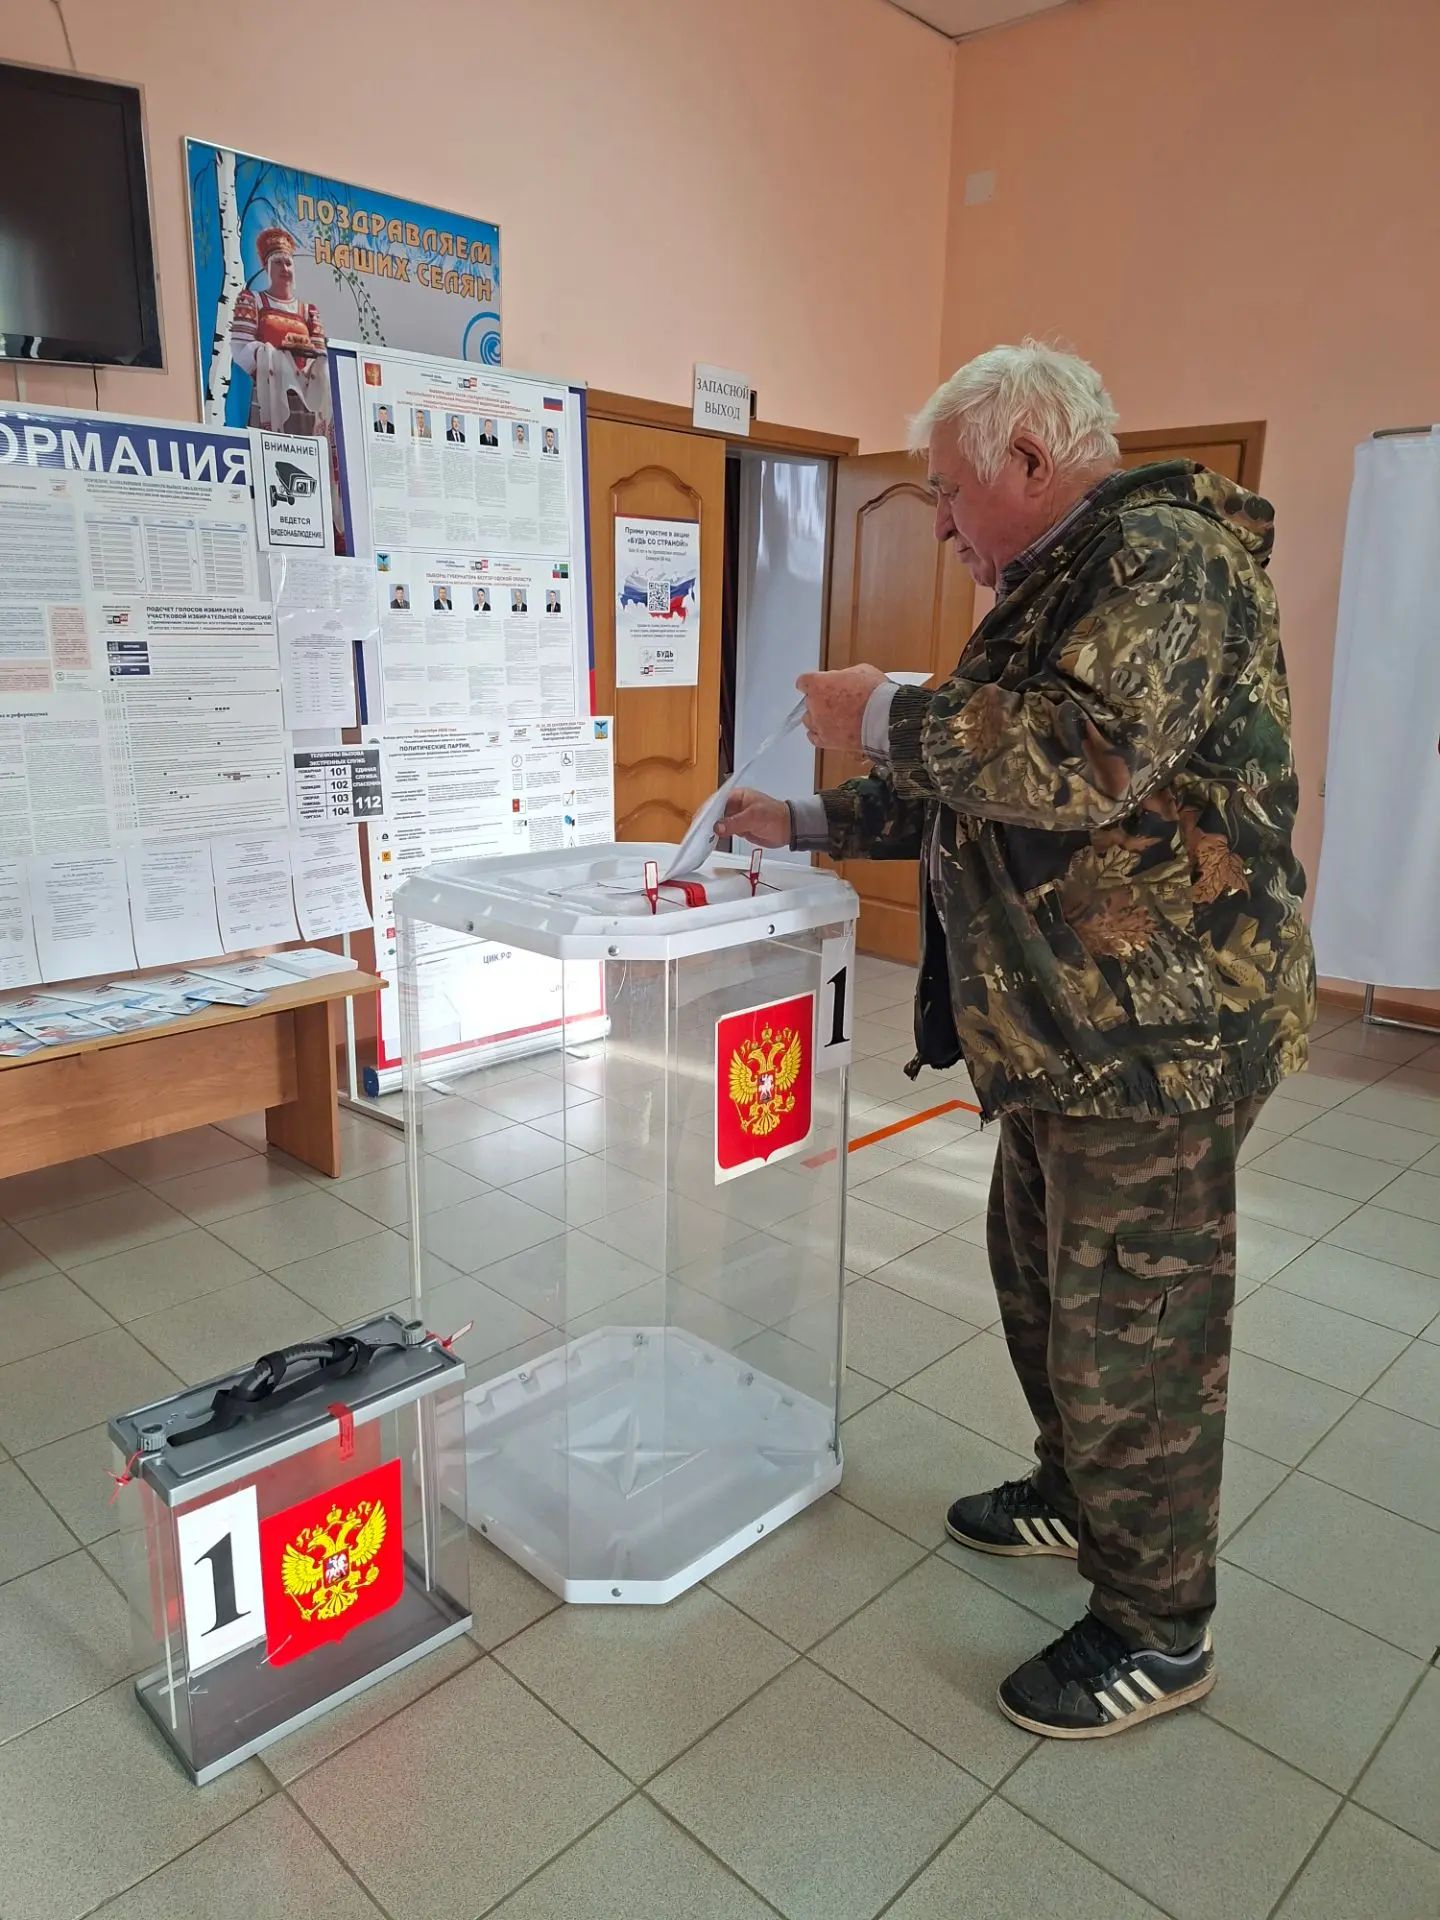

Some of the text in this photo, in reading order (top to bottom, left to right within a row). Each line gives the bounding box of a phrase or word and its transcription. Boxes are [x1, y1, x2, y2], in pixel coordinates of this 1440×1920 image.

[297, 193, 491, 266] ПОЗДРАВЛЯЕМ
[314, 236, 492, 302] НАШИХ СЕЛЯН
[696, 378, 749, 400] ЗАПАСНОЙ
[704, 401, 740, 420] ВЫХОД
[264, 441, 317, 456] ВНИМАНИЕ!
[280, 516, 310, 525] ВЕДЕТСЯ
[270, 528, 321, 539] ВИДЕОНАБЛЮДЕНИЕ
[625, 526, 644, 535] Прими
[656, 650, 674, 658] БУДЬ
[400, 744, 446, 752] ПОЛИТИЧЕСКИЕ
[330, 767, 347, 776] 101
[331, 780, 349, 790] 102
[331, 793, 349, 803] 103
[355, 795, 382, 809] 112
[332, 807, 350, 816] 104
[824, 966, 850, 1048] 1
[193, 1531, 252, 1637] 1
